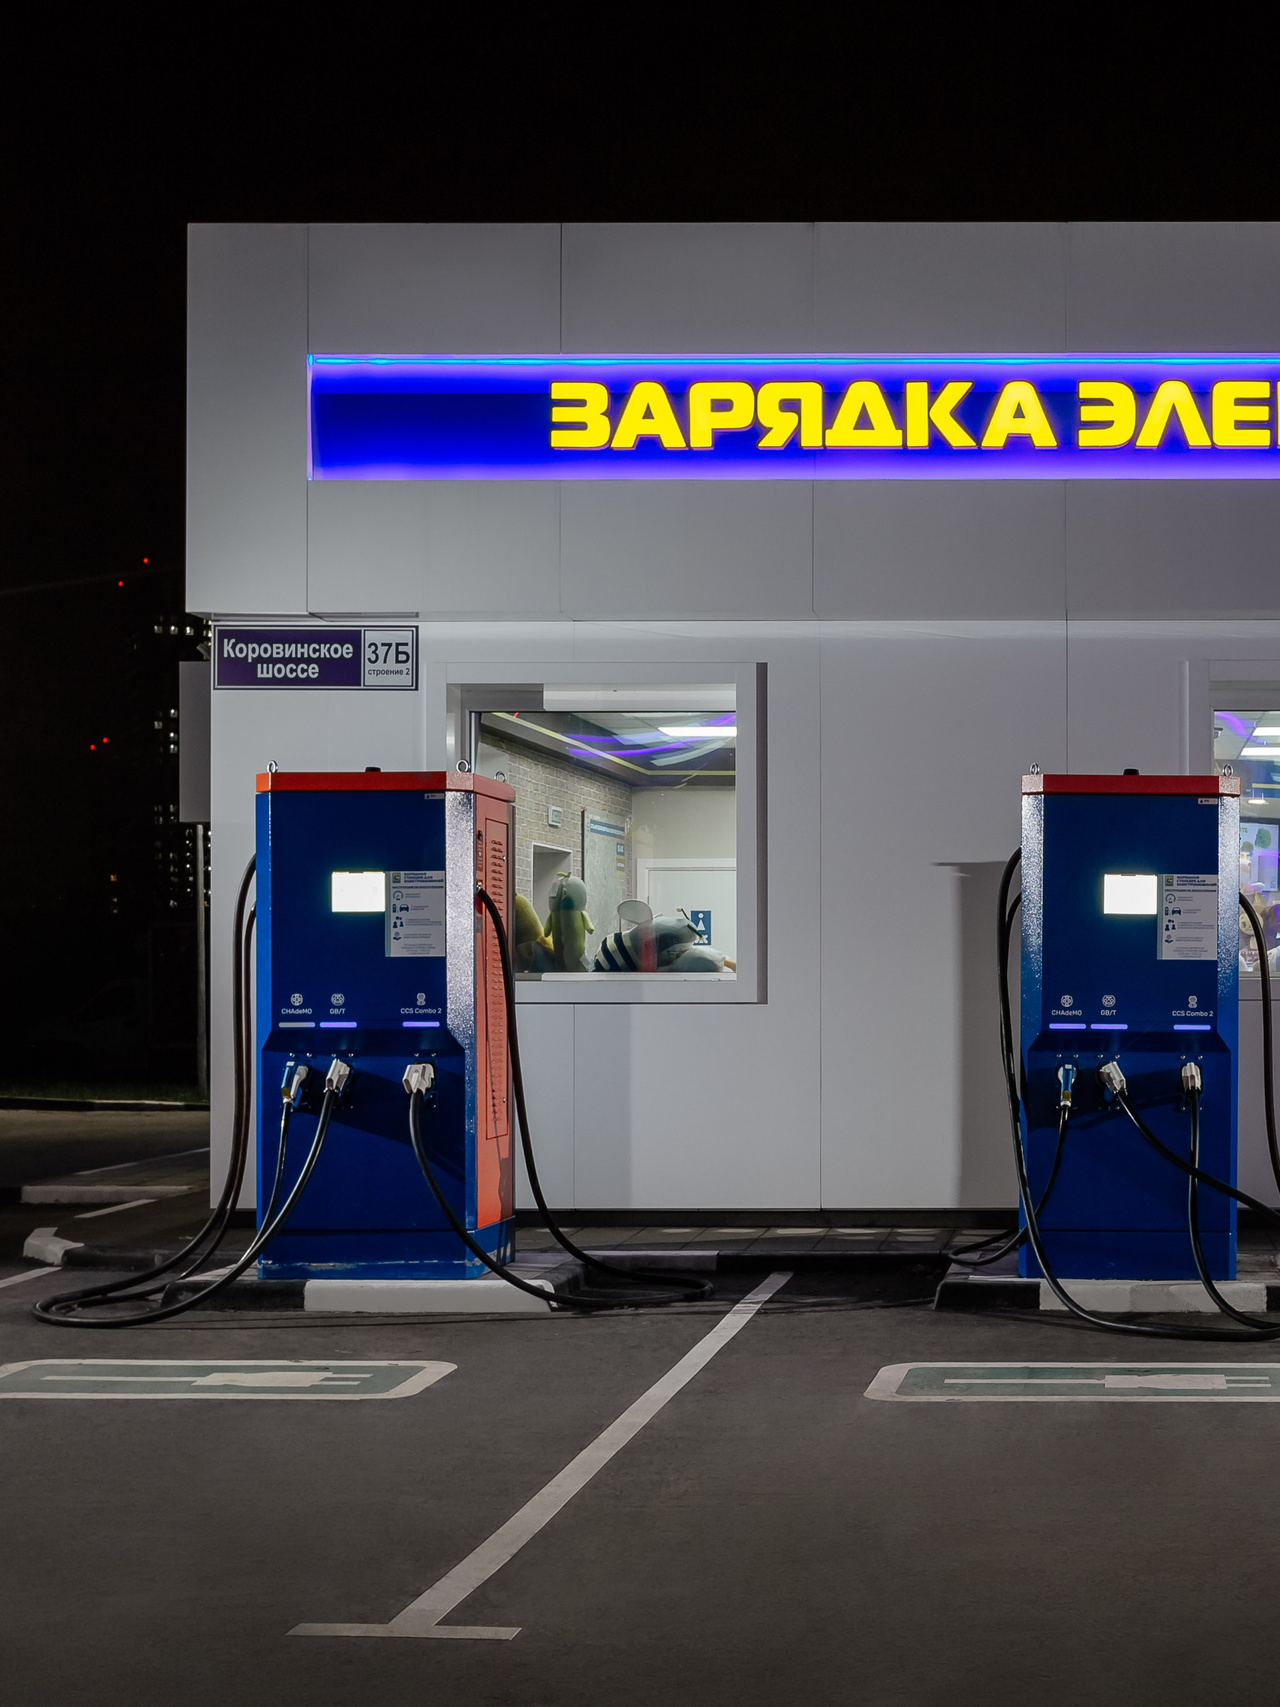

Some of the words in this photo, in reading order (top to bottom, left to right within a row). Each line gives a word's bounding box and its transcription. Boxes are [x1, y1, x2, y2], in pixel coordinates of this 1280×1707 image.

[550, 381, 1058, 450] ЗАРЯДКА
[223, 638, 354, 662] Коровинское
[367, 642, 410, 665] 37Б
[257, 663, 319, 679] шоссе
[368, 668, 403, 676] строение
[405, 667, 410, 676] 2
